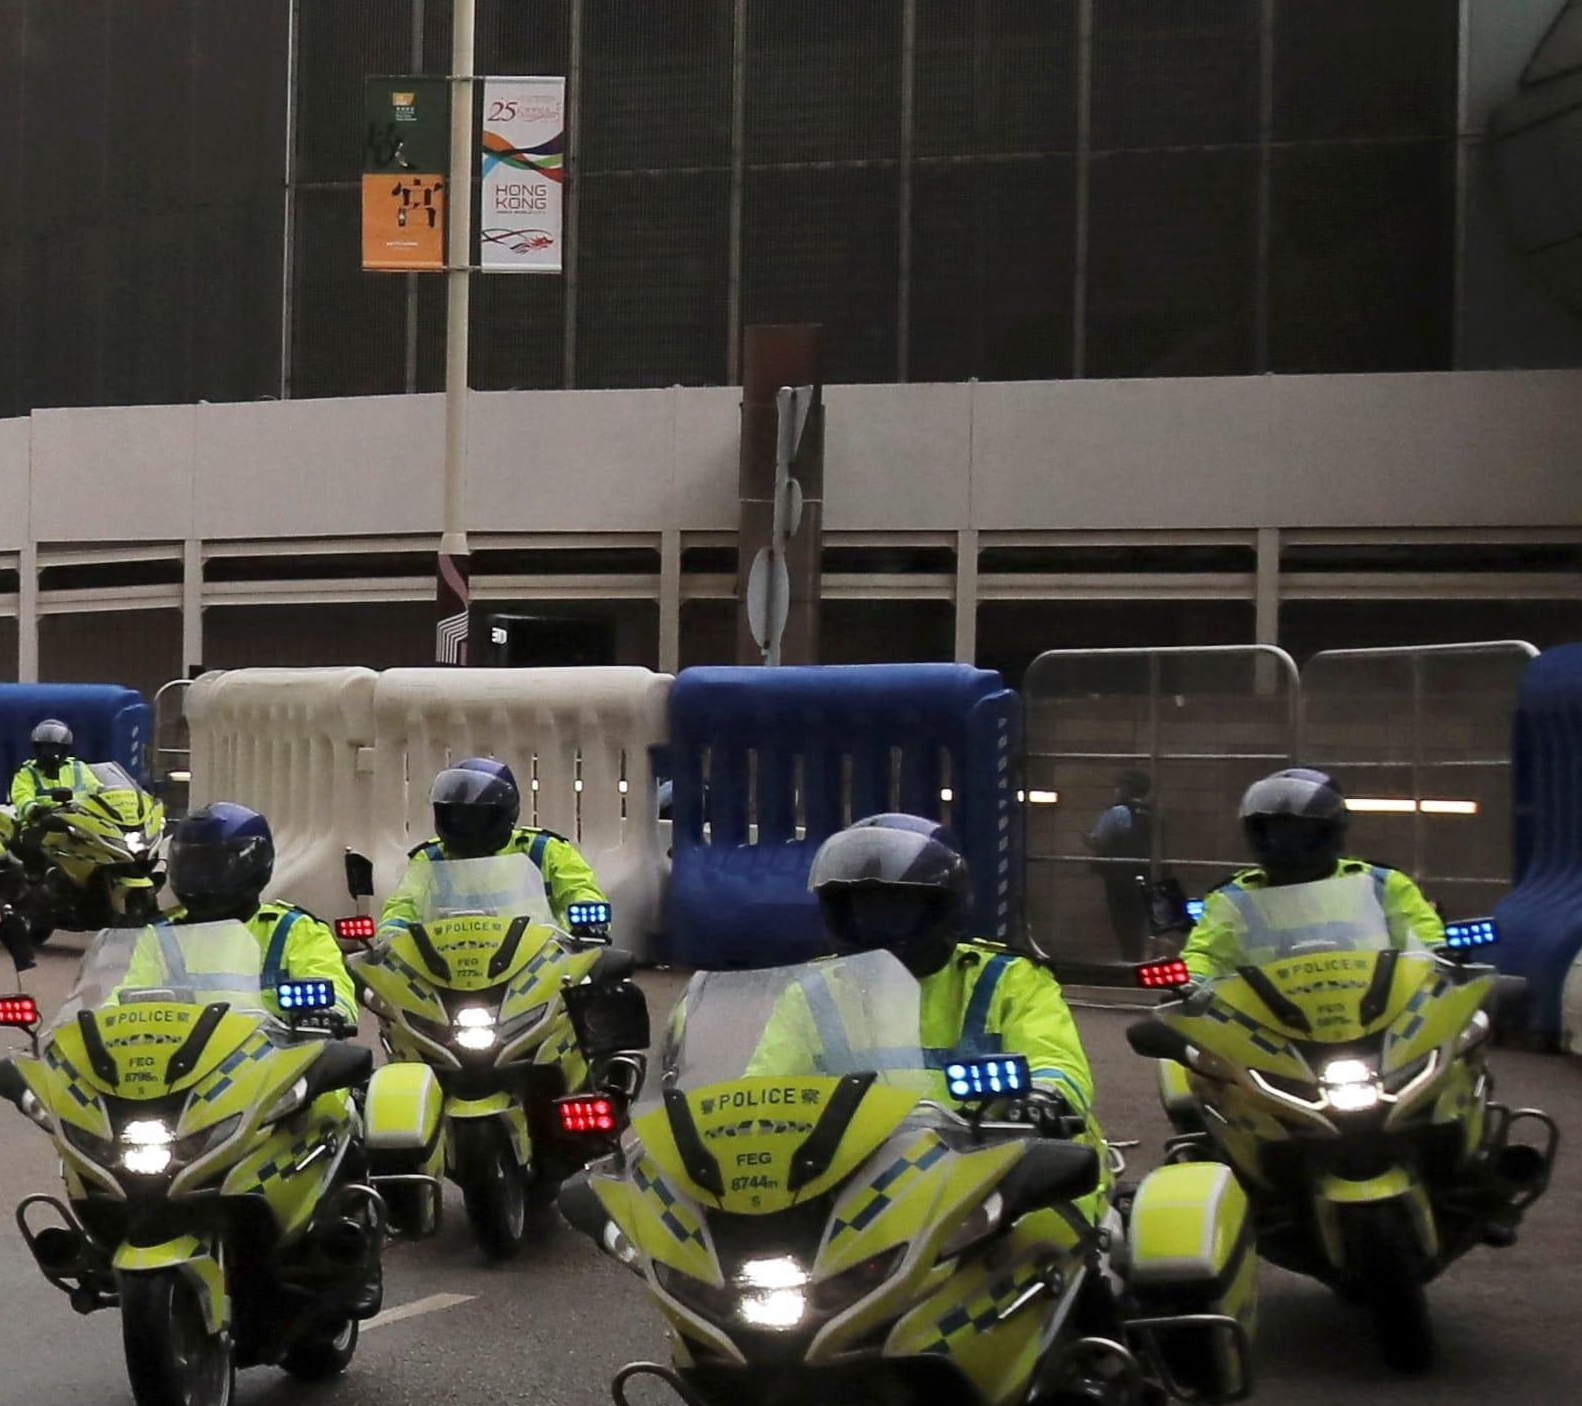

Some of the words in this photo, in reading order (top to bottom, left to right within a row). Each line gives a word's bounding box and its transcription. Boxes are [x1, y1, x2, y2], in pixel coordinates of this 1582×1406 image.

[487, 101, 518, 122] 25
[496, 184, 547, 197] HONG
[496, 197, 547, 210] KONG
[445, 921, 490, 934] POLICE
[1293, 958, 1350, 975] POLICE
[118, 1009, 173, 1024] POLICE
[719, 1087, 797, 1111] POLICE
[736, 1151, 772, 1166] FEG
